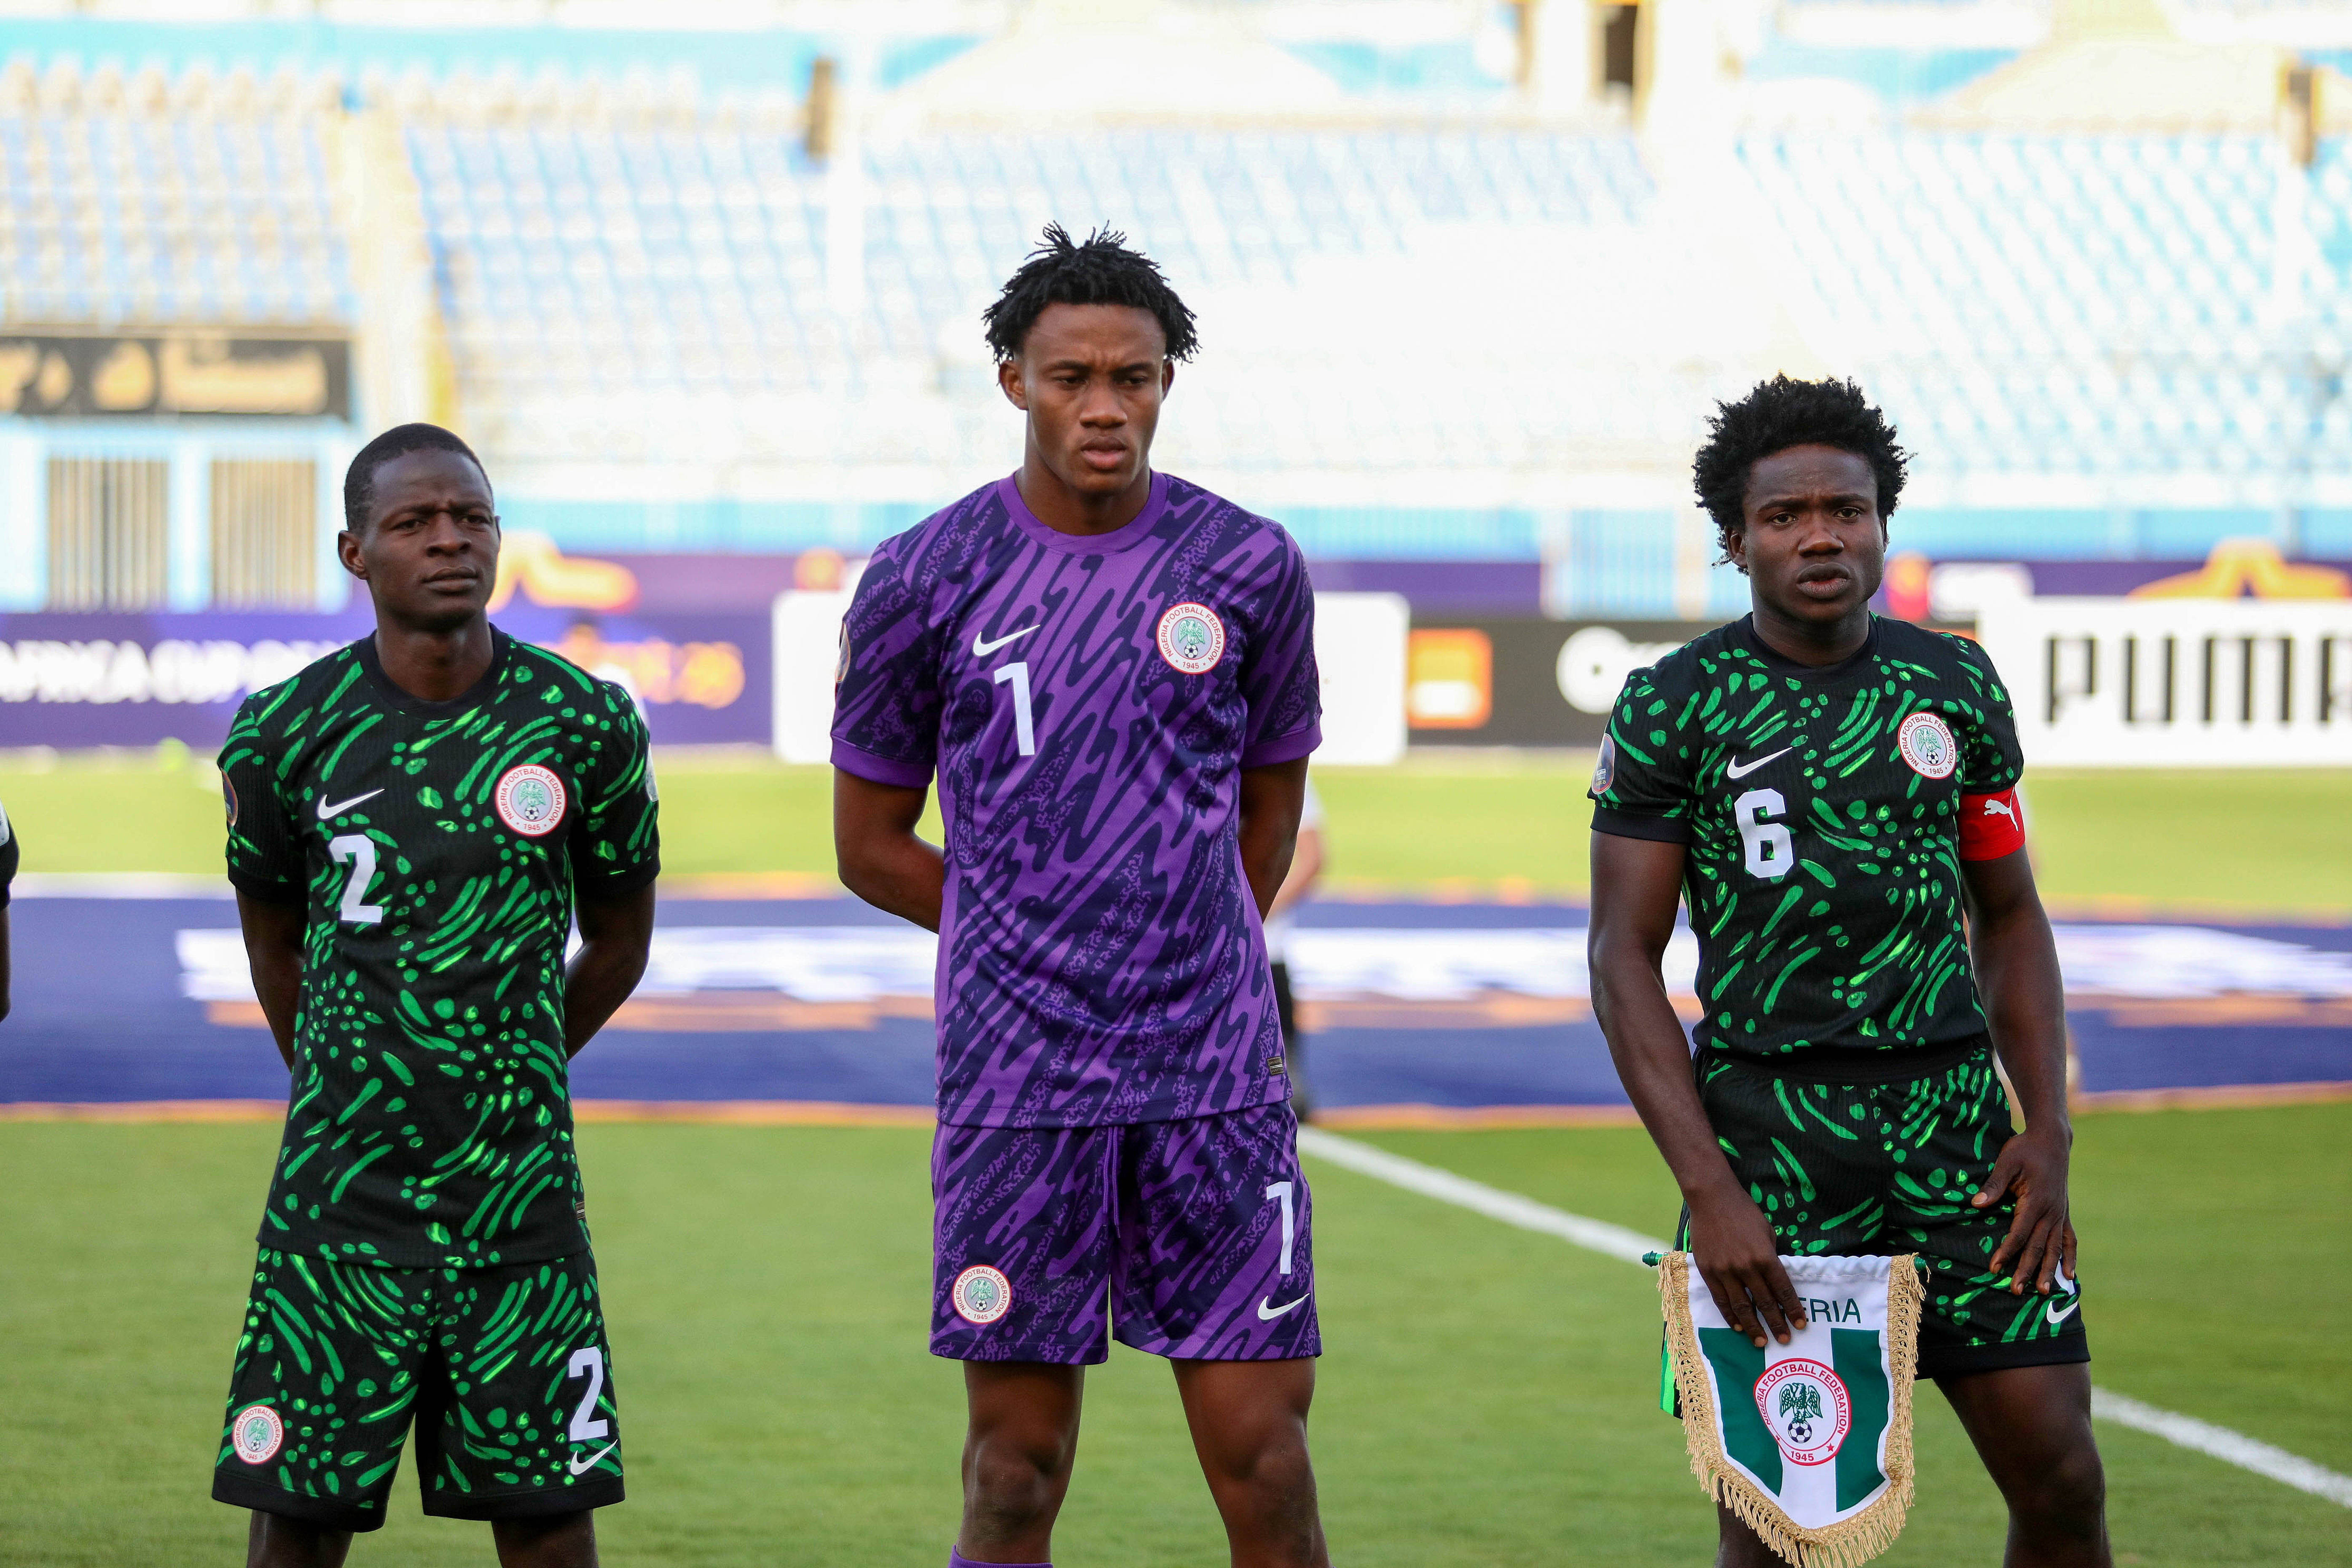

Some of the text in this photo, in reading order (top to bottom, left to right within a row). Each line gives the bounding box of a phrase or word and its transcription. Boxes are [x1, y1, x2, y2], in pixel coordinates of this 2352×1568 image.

[1162, 607, 1221, 663] NIGERIA FOOTBALL FEDERATION
[994, 662, 1034, 755] 1
[1902, 716, 1954, 767] NIGERIA FOOTBALL FEDERATION
[500, 768, 562, 823] NIGERIA FOOTBALL FEDERATION
[1734, 788, 1794, 878] 6
[328, 835, 383, 922] 2
[1267, 1181, 1293, 1274] 1
[956, 1269, 1007, 1313] NIGERIA FOOTBALL FEDERATION
[569, 1346, 608, 1441] 2
[1757, 1364, 1846, 1434] NIGERIA FOOTBALL FEDERATION
[242, 1408, 271, 1420] FOOTBALL
[265, 1416, 280, 1455] FEDERATION
[1791, 1451, 1814, 1461] 1945
